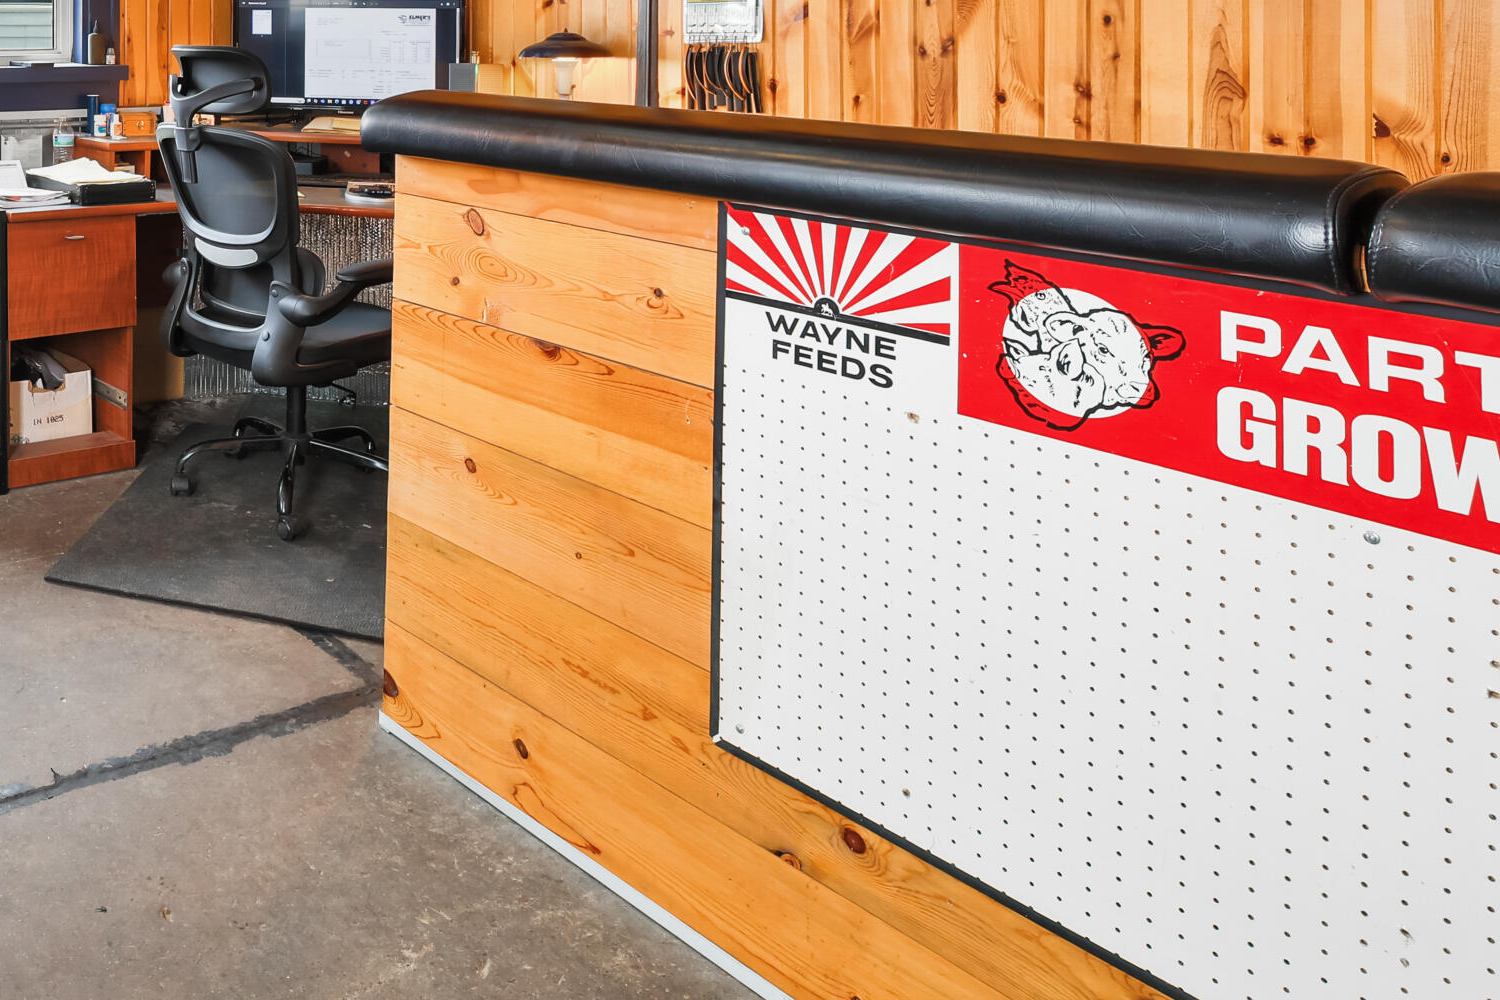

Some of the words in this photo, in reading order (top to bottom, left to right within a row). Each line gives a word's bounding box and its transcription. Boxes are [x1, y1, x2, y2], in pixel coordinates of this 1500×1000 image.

[765, 311, 897, 361] WAYNE
[772, 339, 894, 389] FEEDS
[1220, 310, 1500, 415] PART
[1217, 386, 1500, 524] GROW
